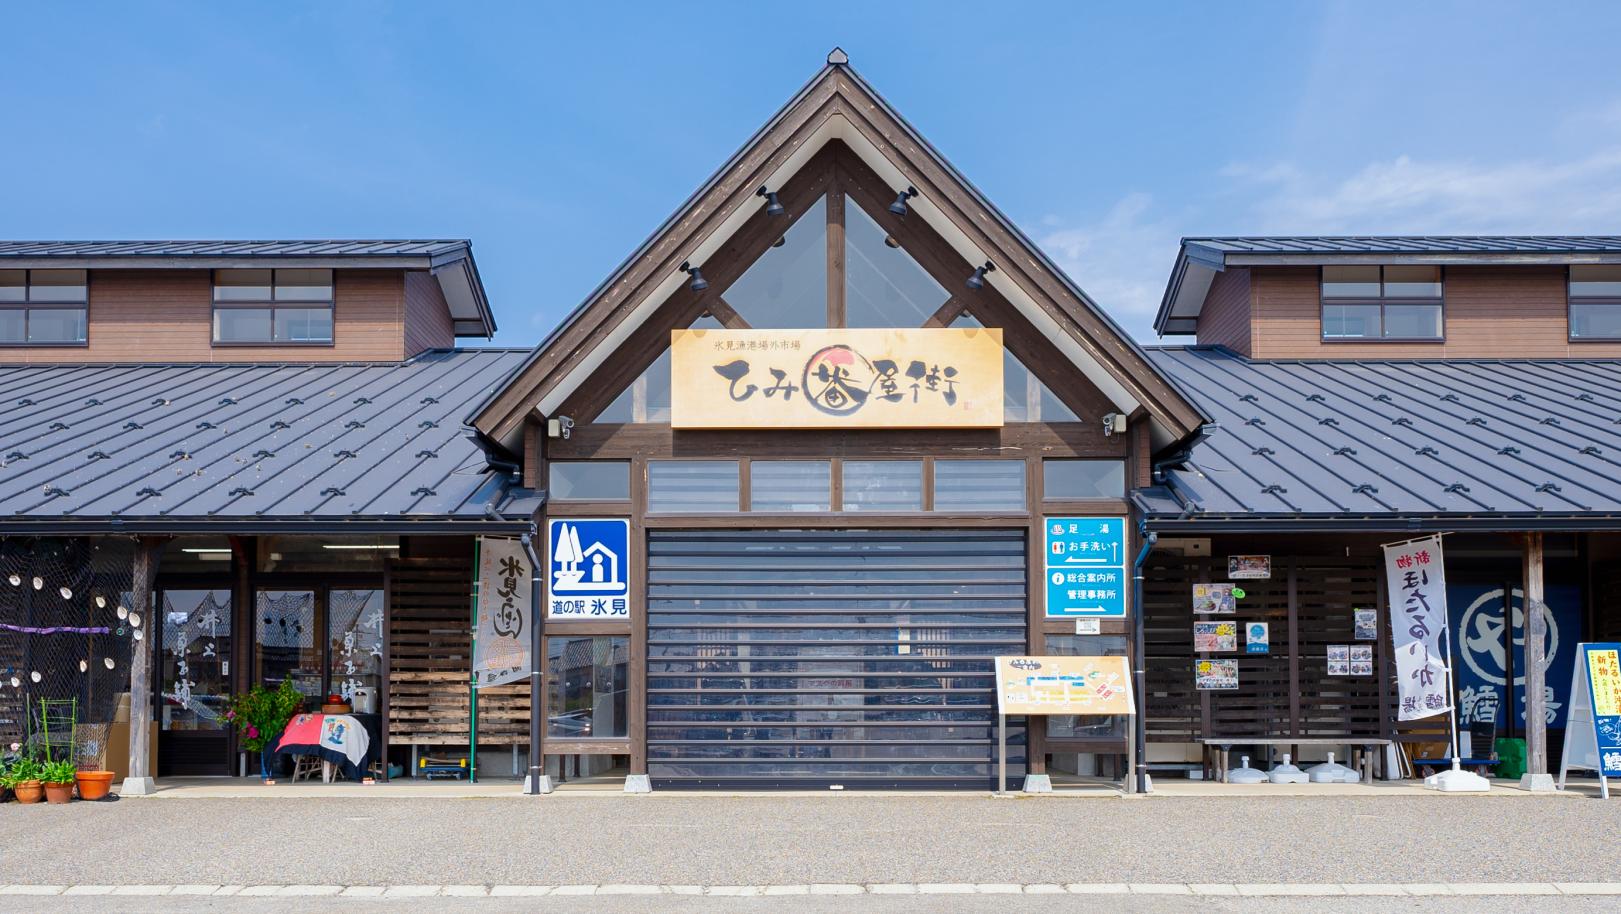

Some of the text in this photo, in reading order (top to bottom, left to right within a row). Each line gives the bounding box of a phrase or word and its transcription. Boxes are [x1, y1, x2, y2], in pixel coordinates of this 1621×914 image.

[713, 340, 801, 351] 氷見漁港場外市場
[712, 354, 961, 411] ひみ番屋街
[1069, 541, 1111, 551] お手洗い
[1067, 573, 1116, 583] 総合案内所
[1067, 590, 1116, 600] 管理事務所
[552, 598, 627, 615] 道の駅 氷見
[1598, 655, 1608, 676] 新物
